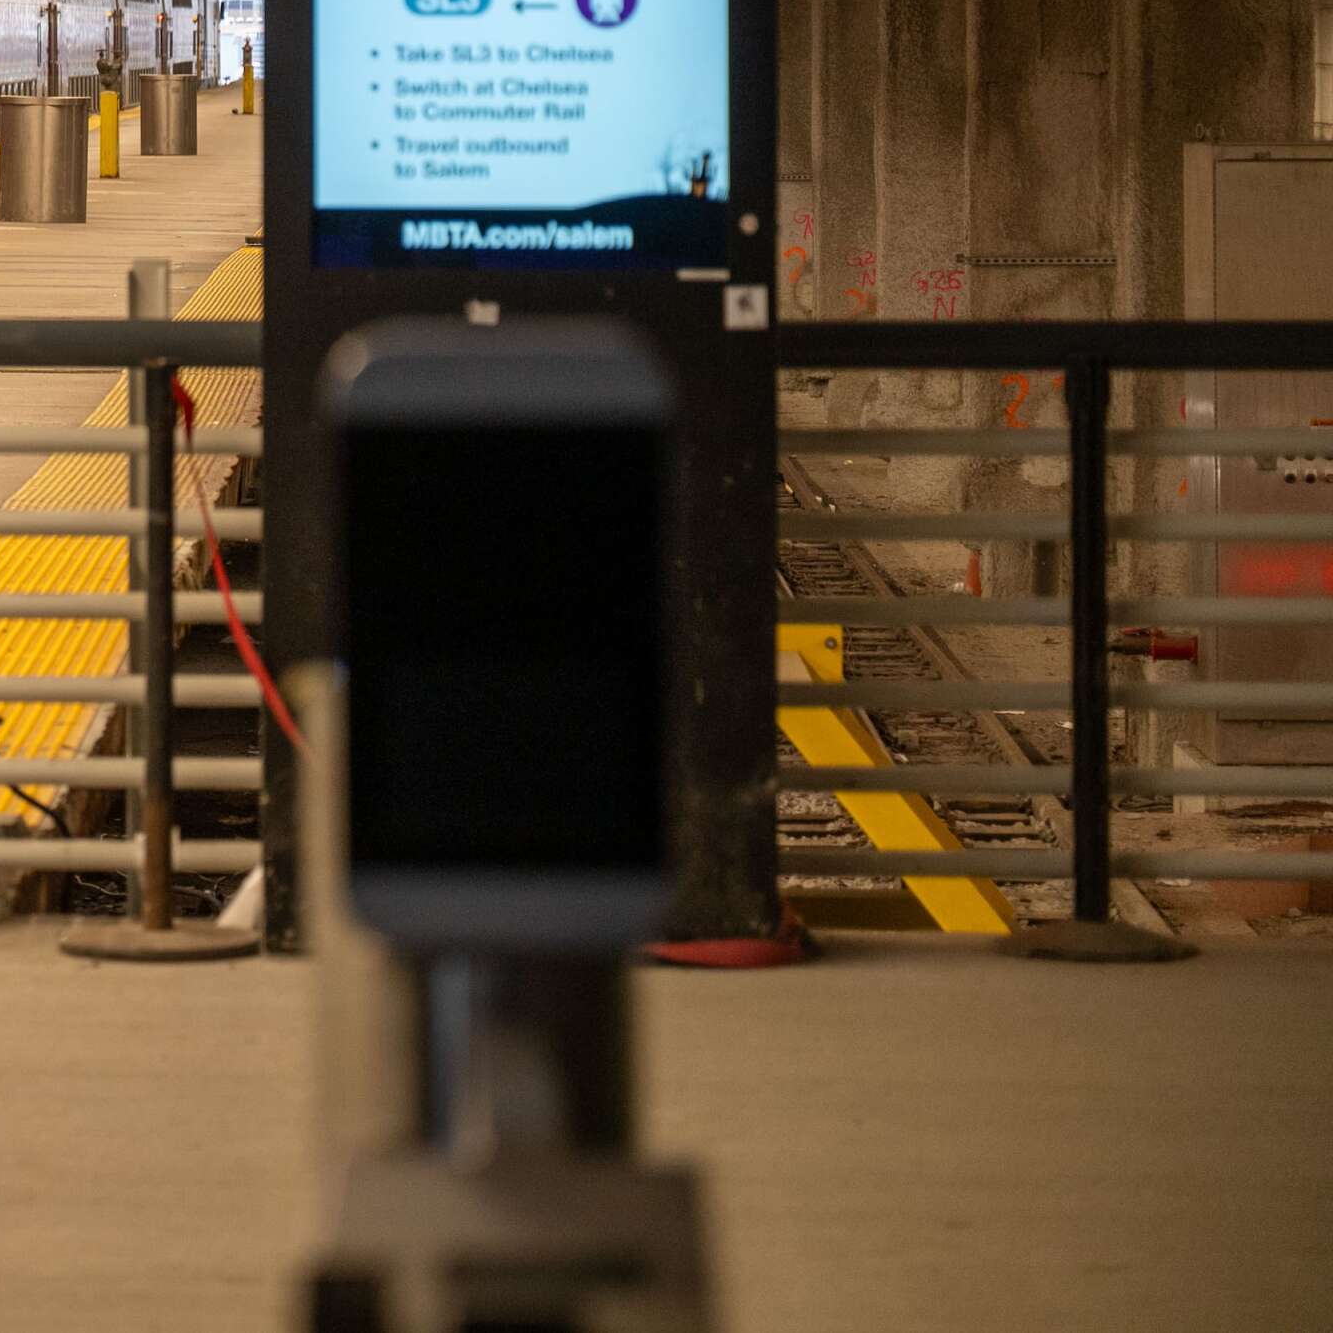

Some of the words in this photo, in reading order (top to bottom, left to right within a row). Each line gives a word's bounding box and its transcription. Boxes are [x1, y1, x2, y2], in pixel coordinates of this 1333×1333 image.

[394, 45, 443, 63] Take
[451, 45, 492, 63] SL3
[498, 45, 519, 63] to
[525, 45, 614, 63] Chelsea
[394, 78, 468, 97] Switch
[474, 79, 496, 97] at
[501, 78, 589, 97] Chelsea
[394, 103, 416, 121] to
[420, 103, 538, 121] Commuter
[544, 102, 585, 121] Rail
[394, 137, 460, 155] Travel
[465, 137, 570, 155] outbound
[394, 161, 416, 179] to
[421, 161, 490, 179] Salem
[401, 221, 634, 251] MBTA.com/salem
